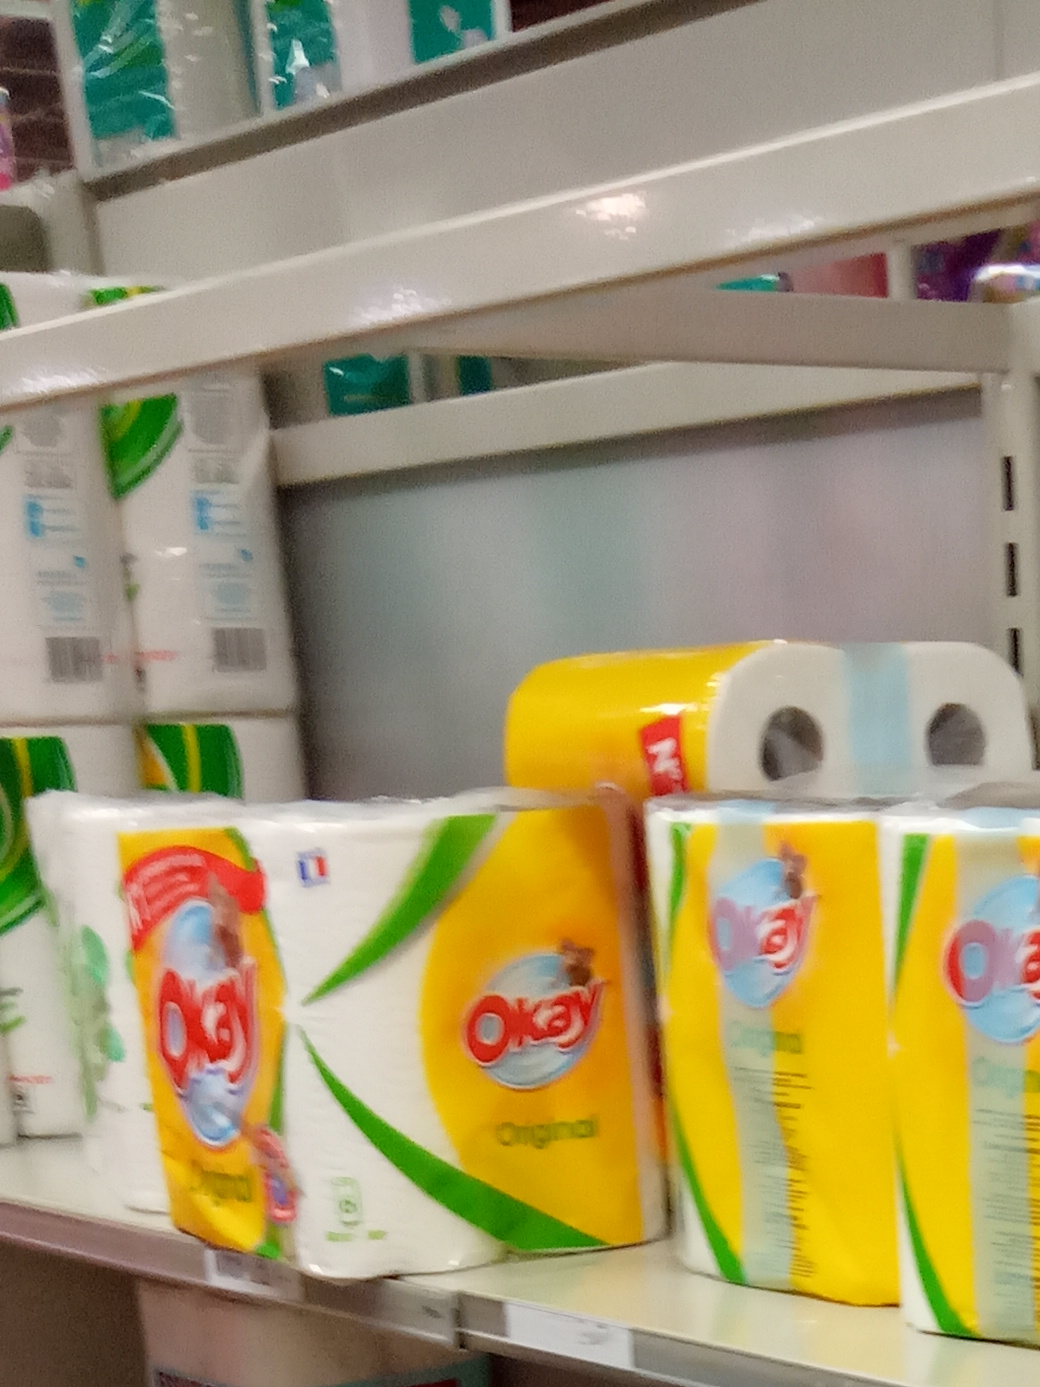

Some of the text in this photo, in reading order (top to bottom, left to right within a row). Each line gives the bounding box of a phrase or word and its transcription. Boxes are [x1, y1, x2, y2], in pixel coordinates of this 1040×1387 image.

[708, 892, 822, 978] Okay
[156, 952, 258, 1098] Okay
[464, 975, 606, 1066] Okay
